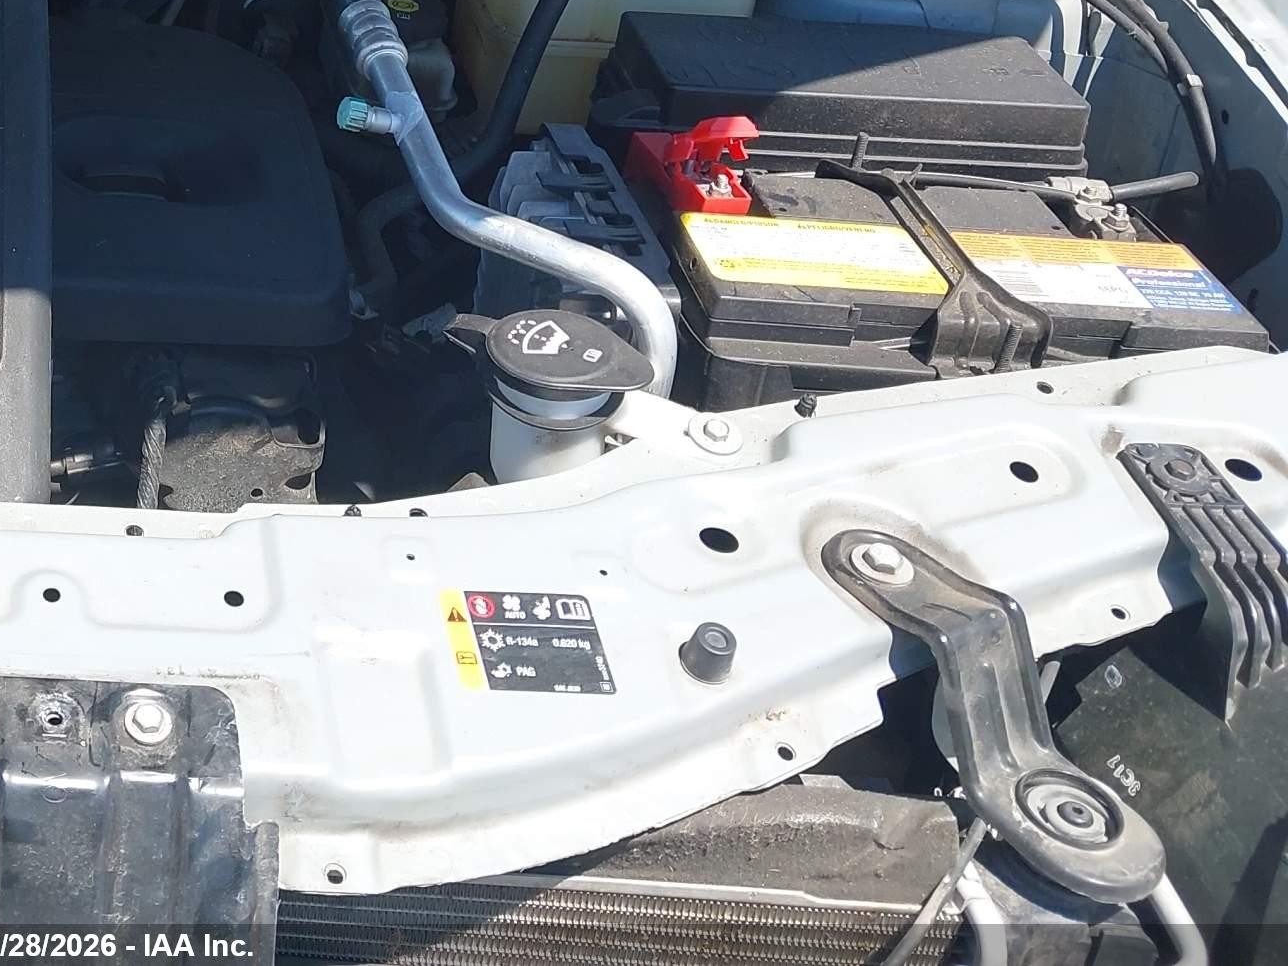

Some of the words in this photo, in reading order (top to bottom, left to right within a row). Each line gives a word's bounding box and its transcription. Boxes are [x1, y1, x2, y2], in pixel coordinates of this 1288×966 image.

[1131, 277, 1207, 288] Professional
[504, 611, 526, 620] AUTO
[505, 636, 539, 647] R-134a
[579, 639, 591, 650] kg
[515, 666, 537, 678] PAG
